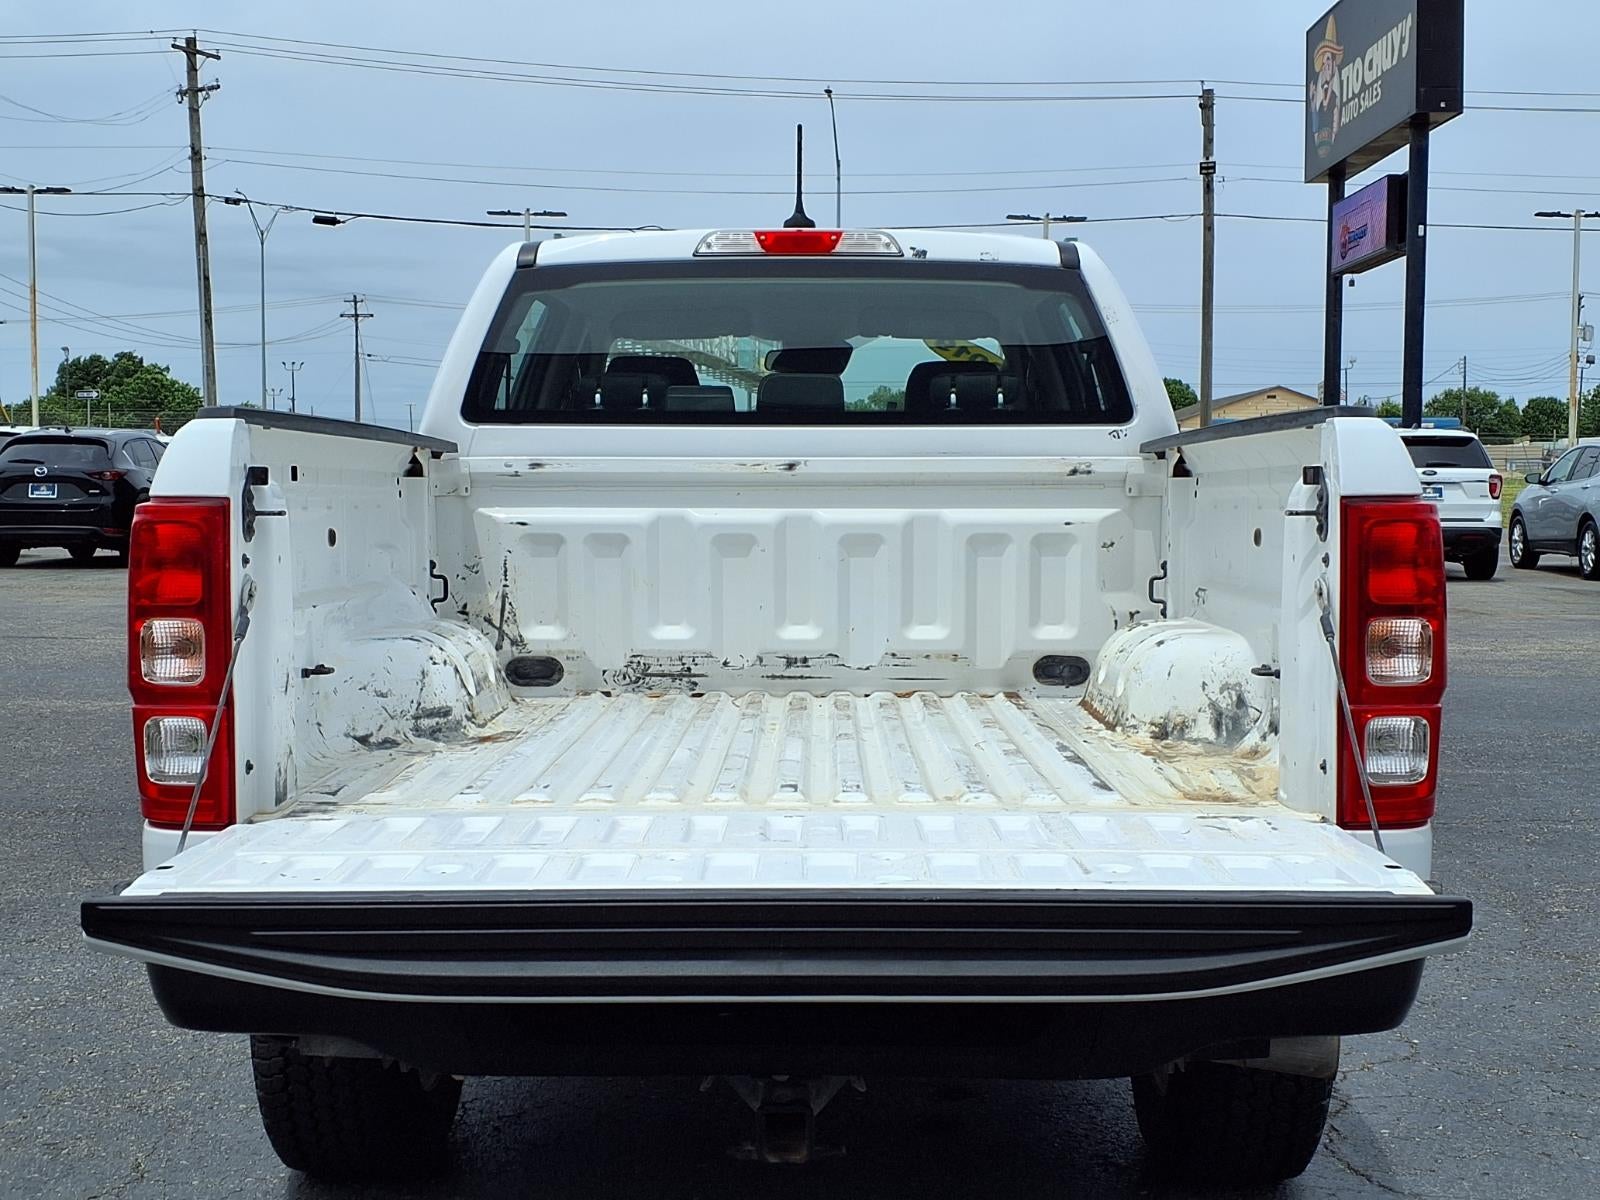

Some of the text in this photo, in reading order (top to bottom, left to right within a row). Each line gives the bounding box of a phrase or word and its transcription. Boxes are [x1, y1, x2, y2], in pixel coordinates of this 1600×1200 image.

[1341, 12, 1412, 103] TIO CHUY'S
[1340, 80, 1382, 127] AUTO SALES
